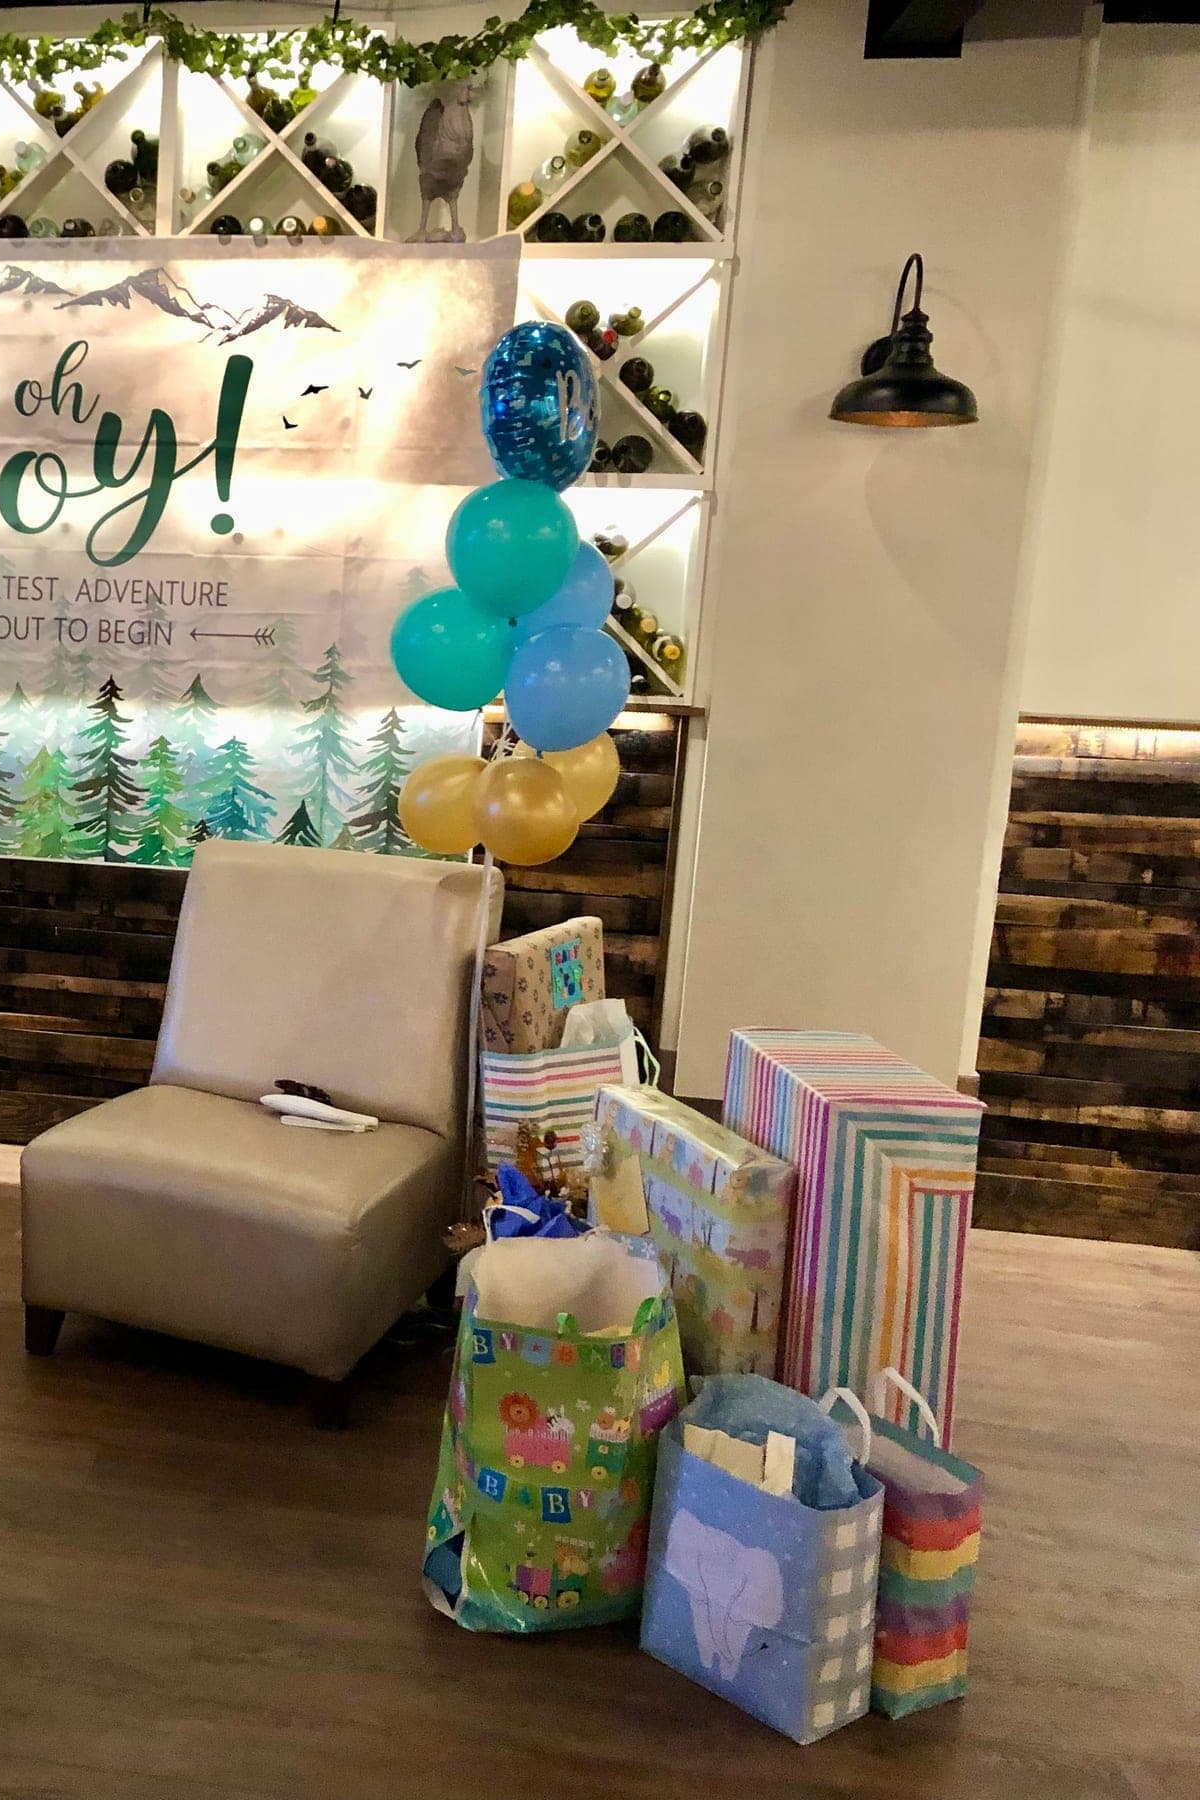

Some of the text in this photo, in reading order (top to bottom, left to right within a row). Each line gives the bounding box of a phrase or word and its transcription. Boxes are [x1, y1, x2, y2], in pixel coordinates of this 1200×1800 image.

[14, 340, 100, 424] oh
[75, 578, 229, 607] ADVENTURE
[54, 616, 88, 643] TO
[98, 619, 173, 646] BEGIN
